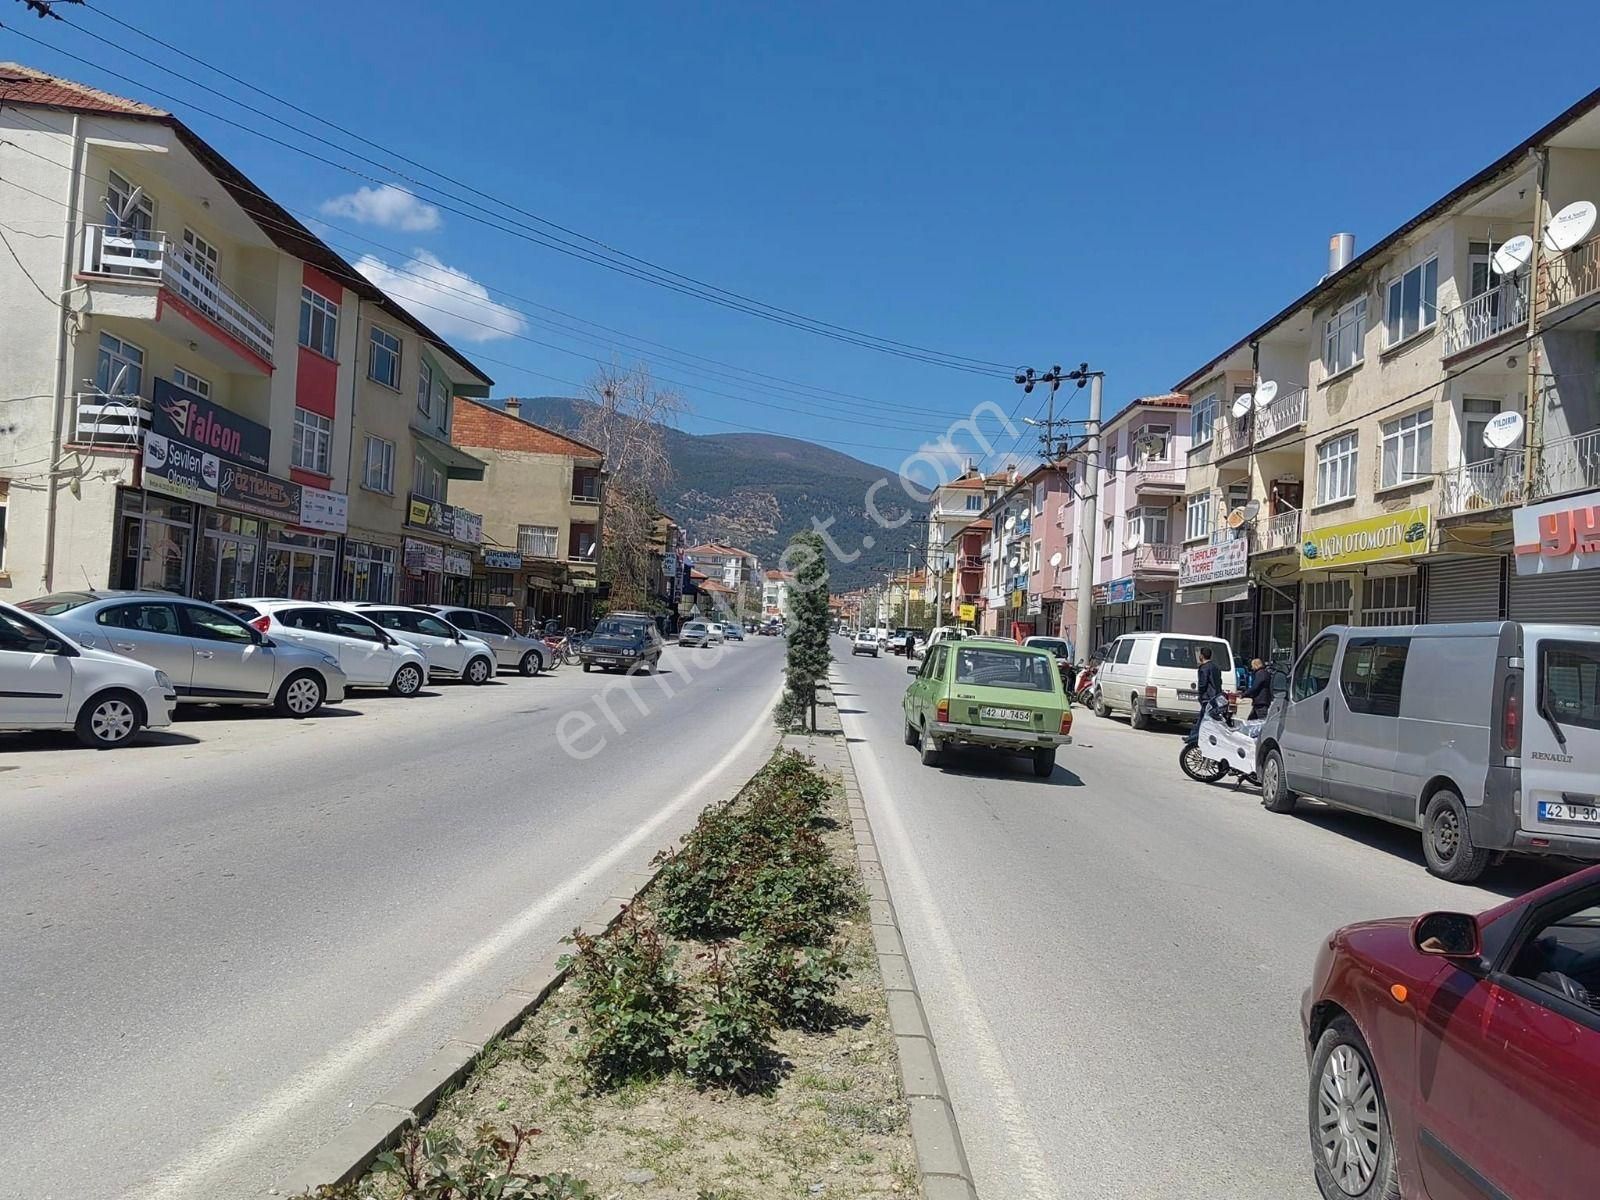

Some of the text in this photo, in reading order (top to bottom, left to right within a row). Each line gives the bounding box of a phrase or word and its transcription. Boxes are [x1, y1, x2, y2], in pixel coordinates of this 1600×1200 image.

[168, 443, 201, 473] Sevilen
[167, 468, 200, 491] Otomotiv
[1345, 520, 1405, 554] OTOMOTİV
[986, 708, 996, 717] 42
[1010, 711, 1029, 720] 7454
[1532, 752, 1573, 763] RENAULT
[1547, 805, 1562, 817] 42
[1568, 806, 1577, 819] U
